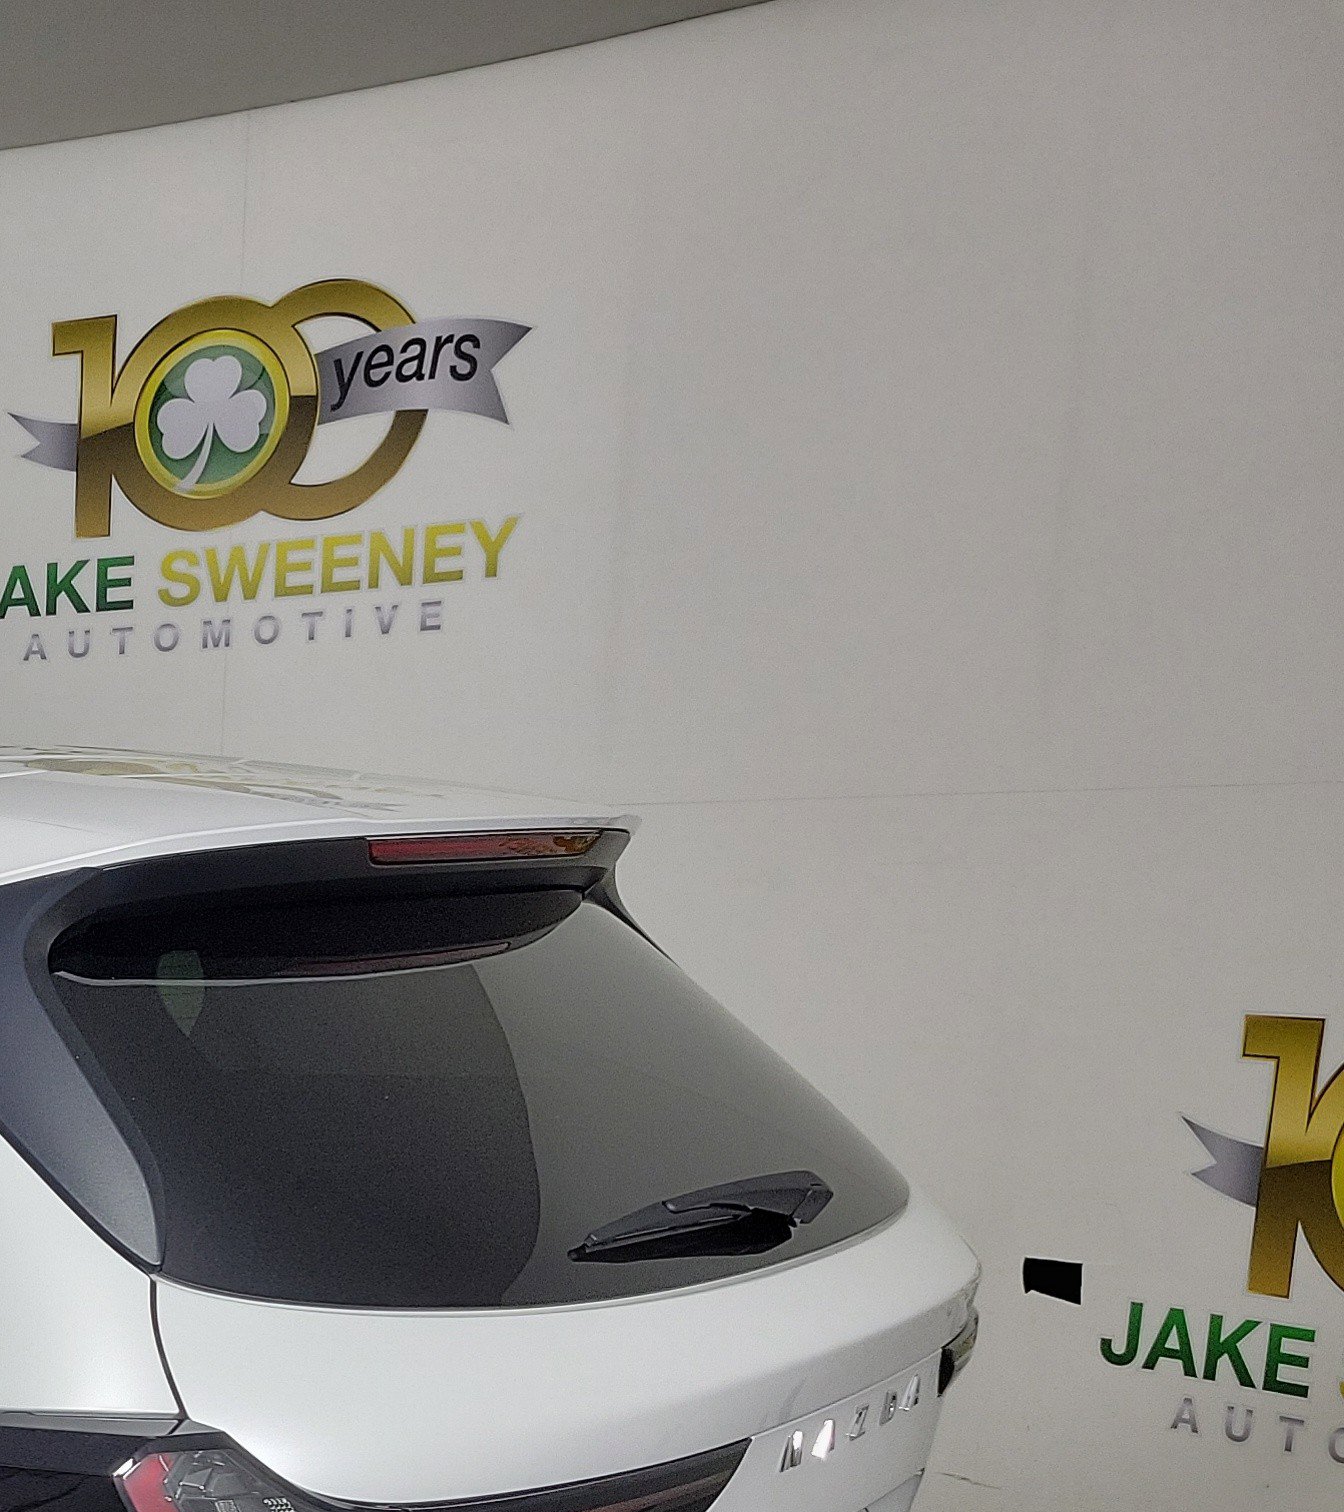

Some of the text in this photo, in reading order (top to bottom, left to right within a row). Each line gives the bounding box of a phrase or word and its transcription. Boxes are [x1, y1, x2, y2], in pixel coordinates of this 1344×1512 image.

[330, 331, 481, 411] years
[157, 514, 520, 608] SWEENEY
[22, 599, 444, 662] AUTOMOTIVE
[1100, 1301, 1316, 1399] JAKE
